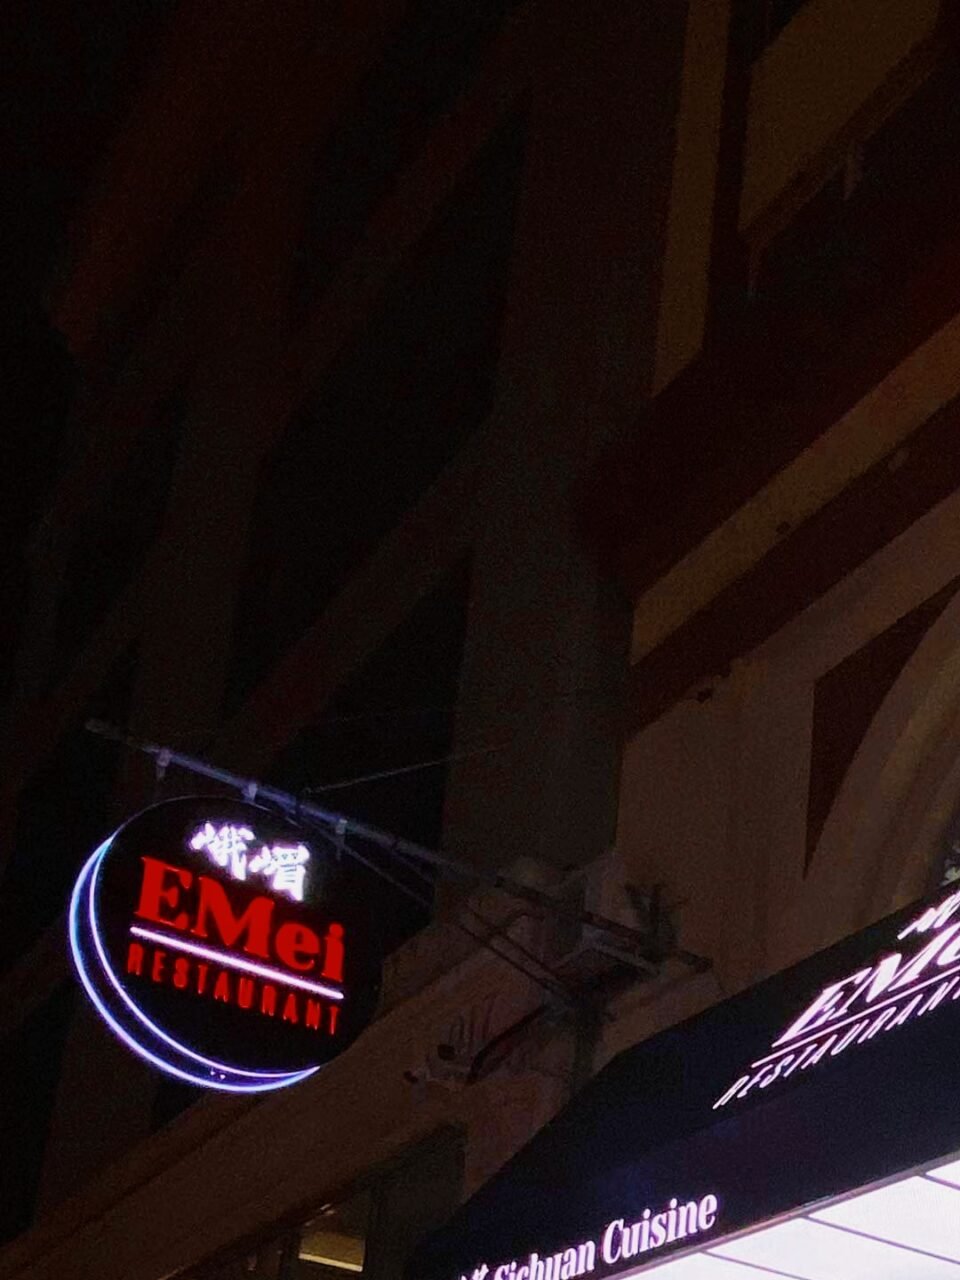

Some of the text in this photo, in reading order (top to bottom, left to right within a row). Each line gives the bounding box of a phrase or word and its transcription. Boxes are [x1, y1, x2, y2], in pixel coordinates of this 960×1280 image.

[133, 855, 346, 983] EMei
[126, 942, 342, 1036] RESTAURANT
[602, 1193, 720, 1266] Cuisine
